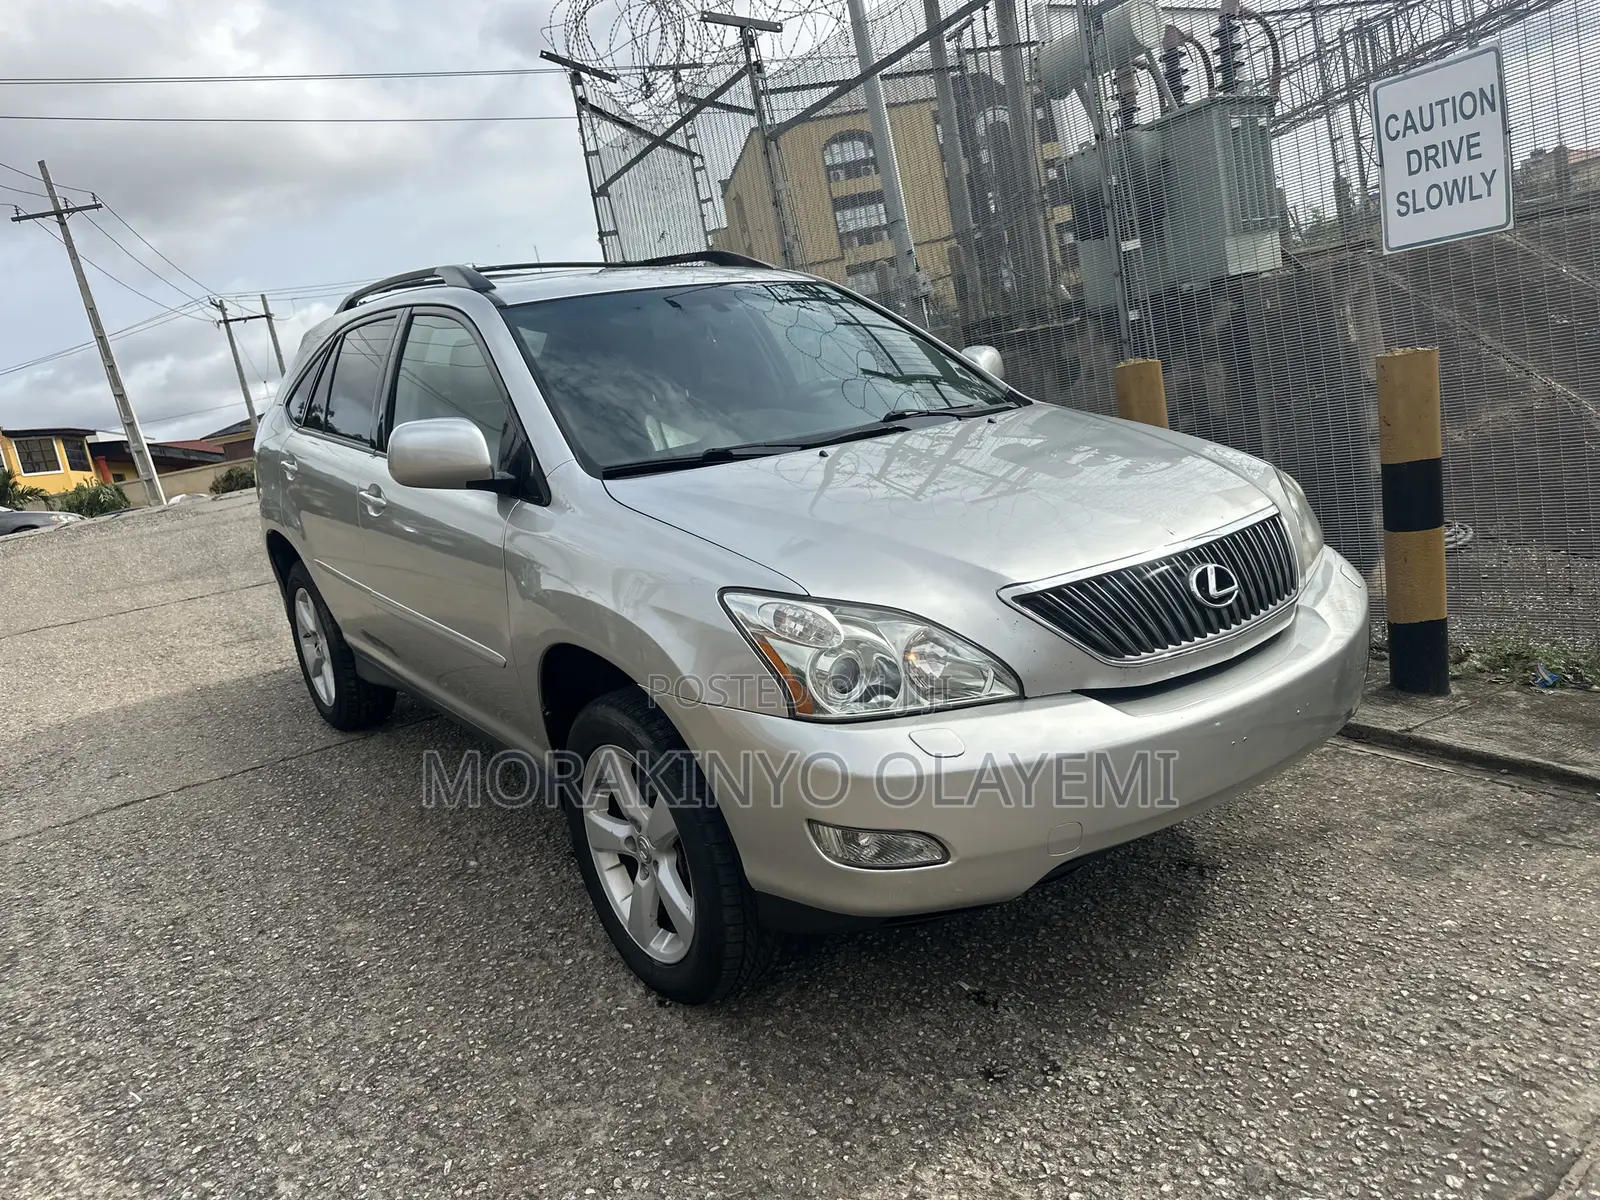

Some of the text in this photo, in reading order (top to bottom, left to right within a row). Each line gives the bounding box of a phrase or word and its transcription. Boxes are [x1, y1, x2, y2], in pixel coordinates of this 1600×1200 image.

[1384, 84, 1496, 141] CAUTION
[1406, 131, 1482, 176] DRIVE
[1396, 169, 1497, 217] SLOWLY
